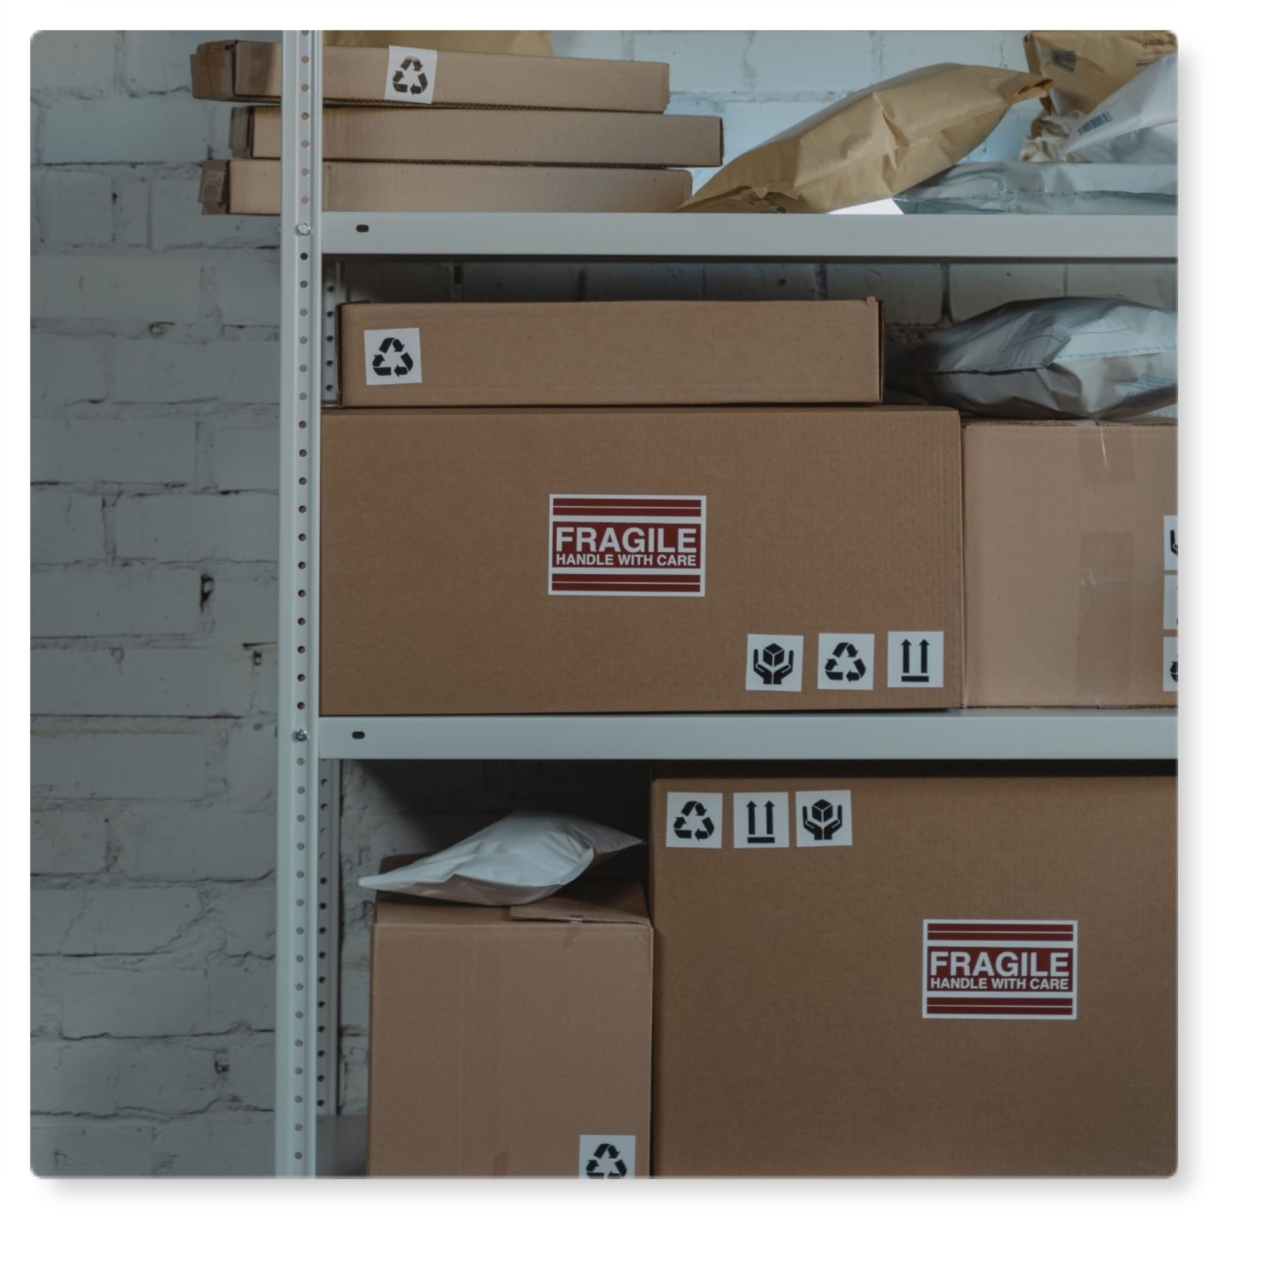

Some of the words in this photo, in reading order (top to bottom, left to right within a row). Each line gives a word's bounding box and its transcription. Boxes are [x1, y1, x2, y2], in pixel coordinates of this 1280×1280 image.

[555, 526, 698, 554] FRAGILE
[555, 553, 614, 566] HANDLE
[618, 554, 654, 567] WITH
[656, 554, 697, 567] CARE
[930, 951, 1070, 977] FRAGILE
[930, 977, 988, 989] HANDLE
[991, 977, 1027, 990] WITH
[1029, 978, 1070, 990] CARE
